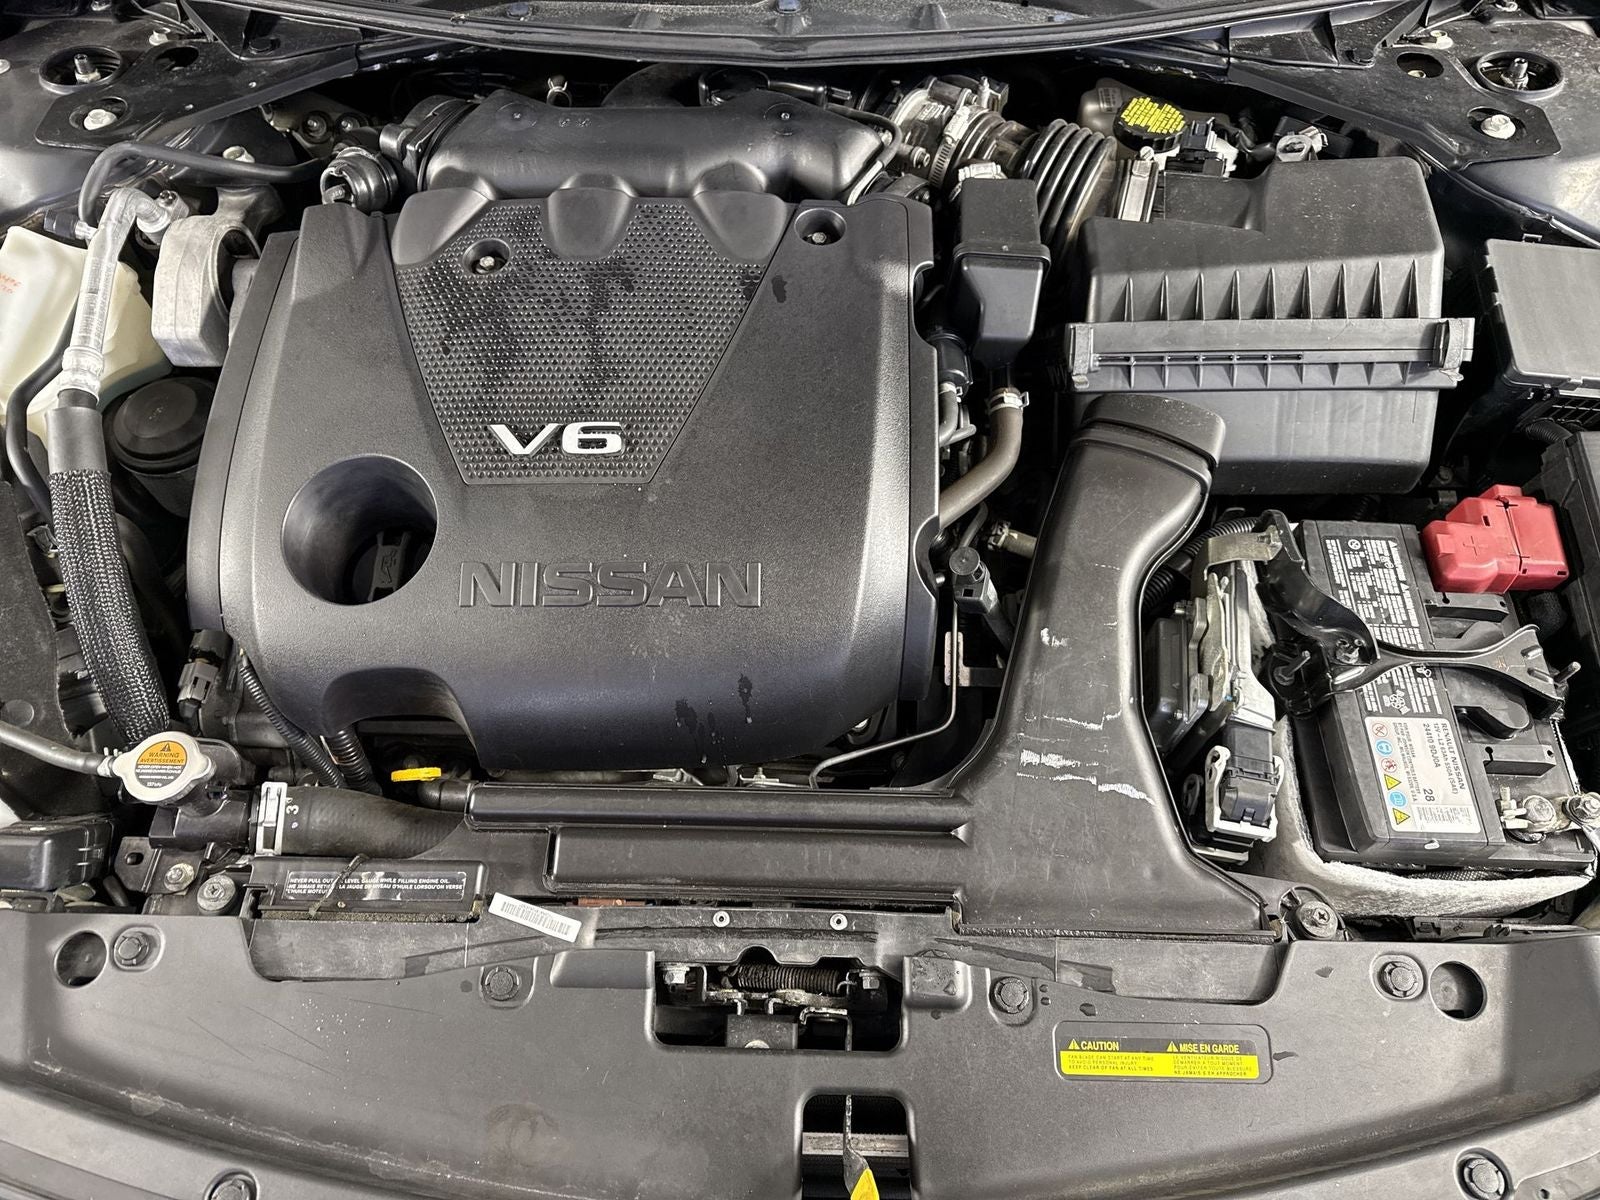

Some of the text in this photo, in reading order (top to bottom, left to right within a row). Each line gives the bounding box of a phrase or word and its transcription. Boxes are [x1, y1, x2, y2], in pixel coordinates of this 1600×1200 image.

[489, 421, 625, 455] V6
[458, 562, 762, 607] NISSAN
[1423, 724, 1434, 743] 24410
[1441, 723, 1465, 789] RENAULT NISSAN
[1423, 788, 1436, 801] 28
[1080, 1041, 1119, 1051] CAUTION
[1179, 1043, 1239, 1053] MISE EN GARDE
